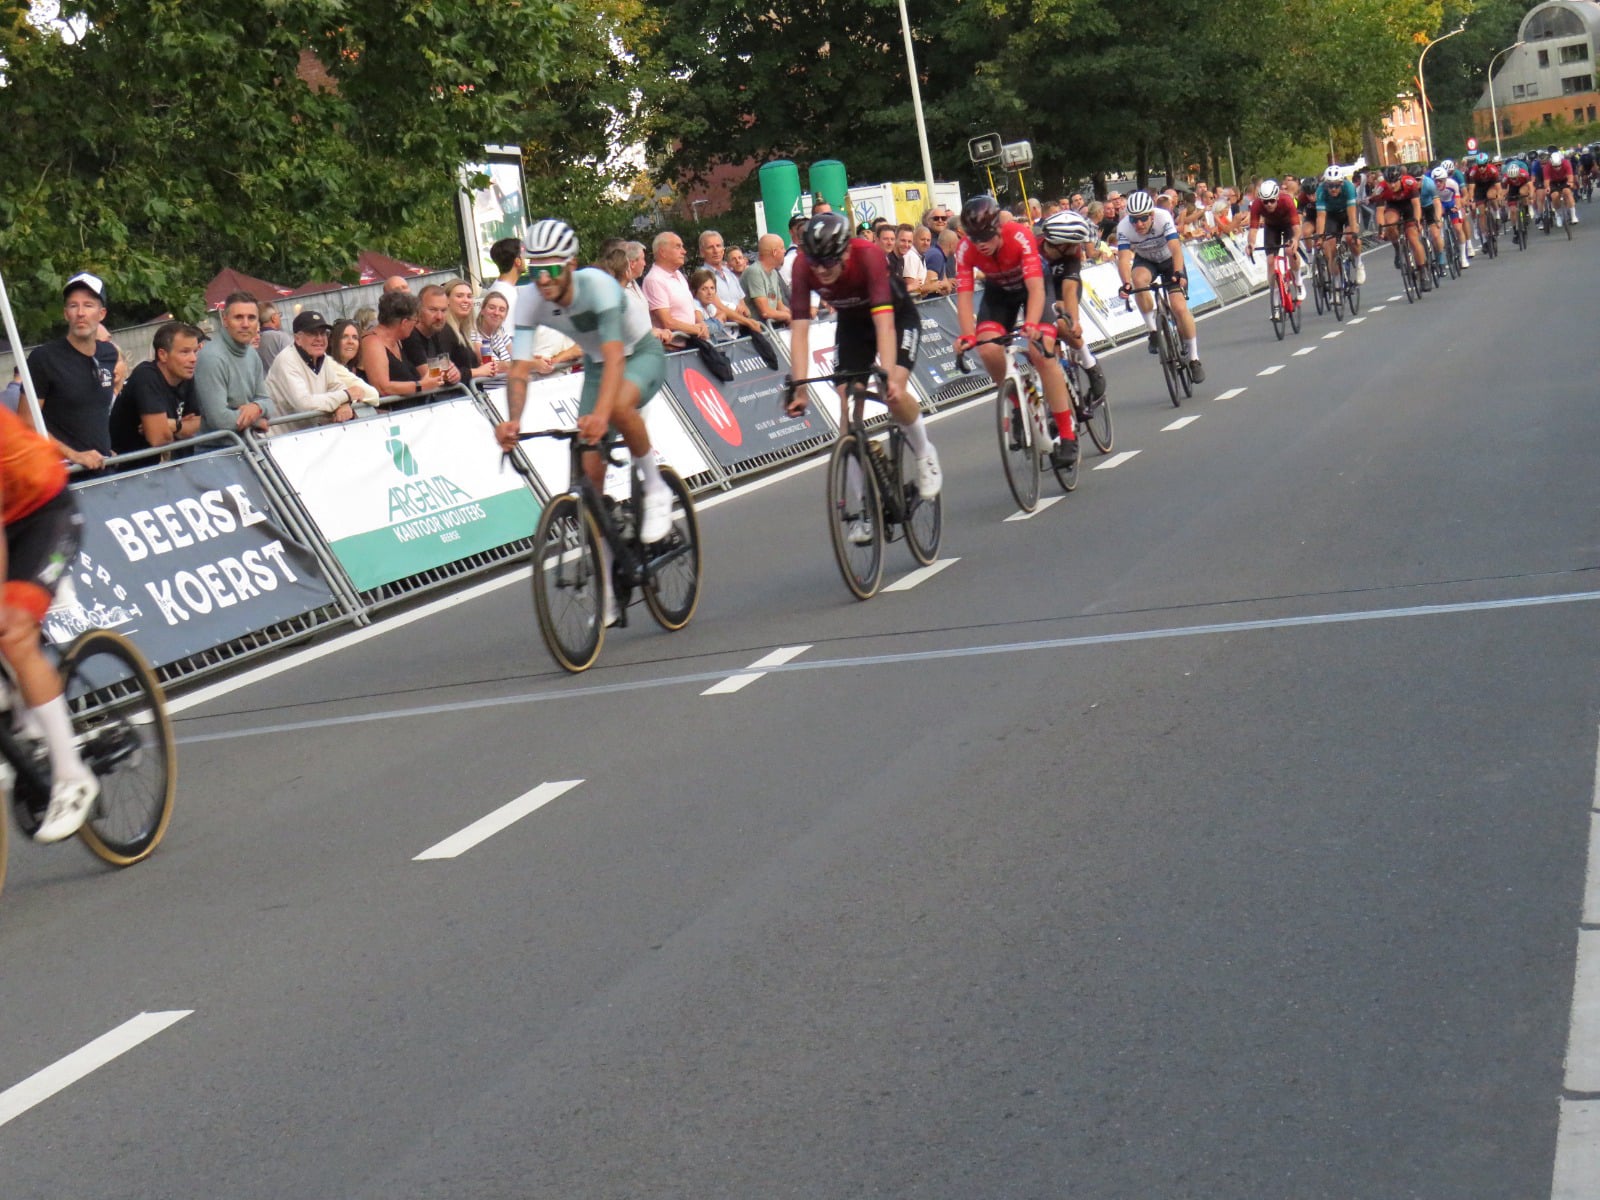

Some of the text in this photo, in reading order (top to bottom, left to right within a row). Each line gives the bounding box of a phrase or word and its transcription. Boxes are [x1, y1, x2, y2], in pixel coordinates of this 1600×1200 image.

[693, 388, 732, 429] W
[388, 475, 473, 522] ARGENTA
[105, 484, 267, 562] BEERSE
[393, 503, 487, 543] KANTOOR WOUTERS
[440, 530, 461, 543] BEERSE
[144, 540, 298, 625] KOERST
